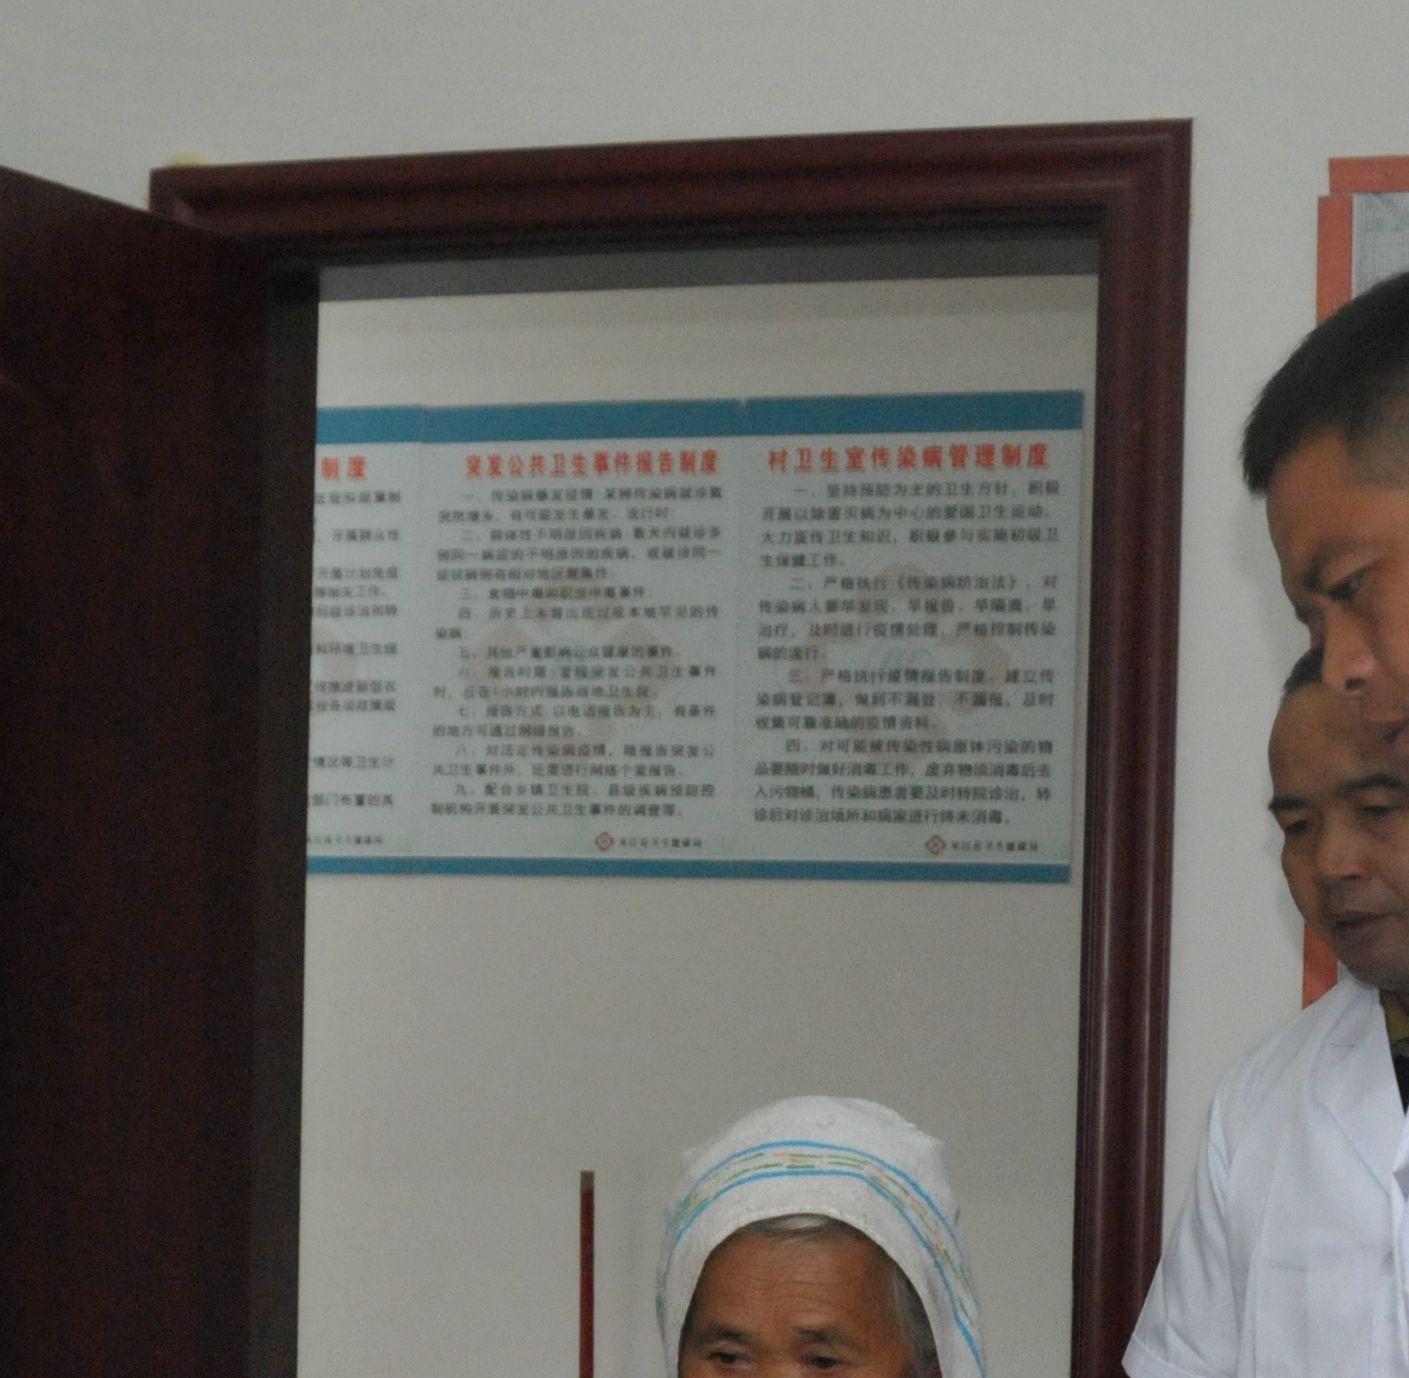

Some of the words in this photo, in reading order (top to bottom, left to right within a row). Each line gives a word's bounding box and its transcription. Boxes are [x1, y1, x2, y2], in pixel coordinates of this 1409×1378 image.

[466, 448, 720, 479] 突发公共卫生事件报告制度
[767, 441, 1051, 473] 村卫生室传染病管理制度
